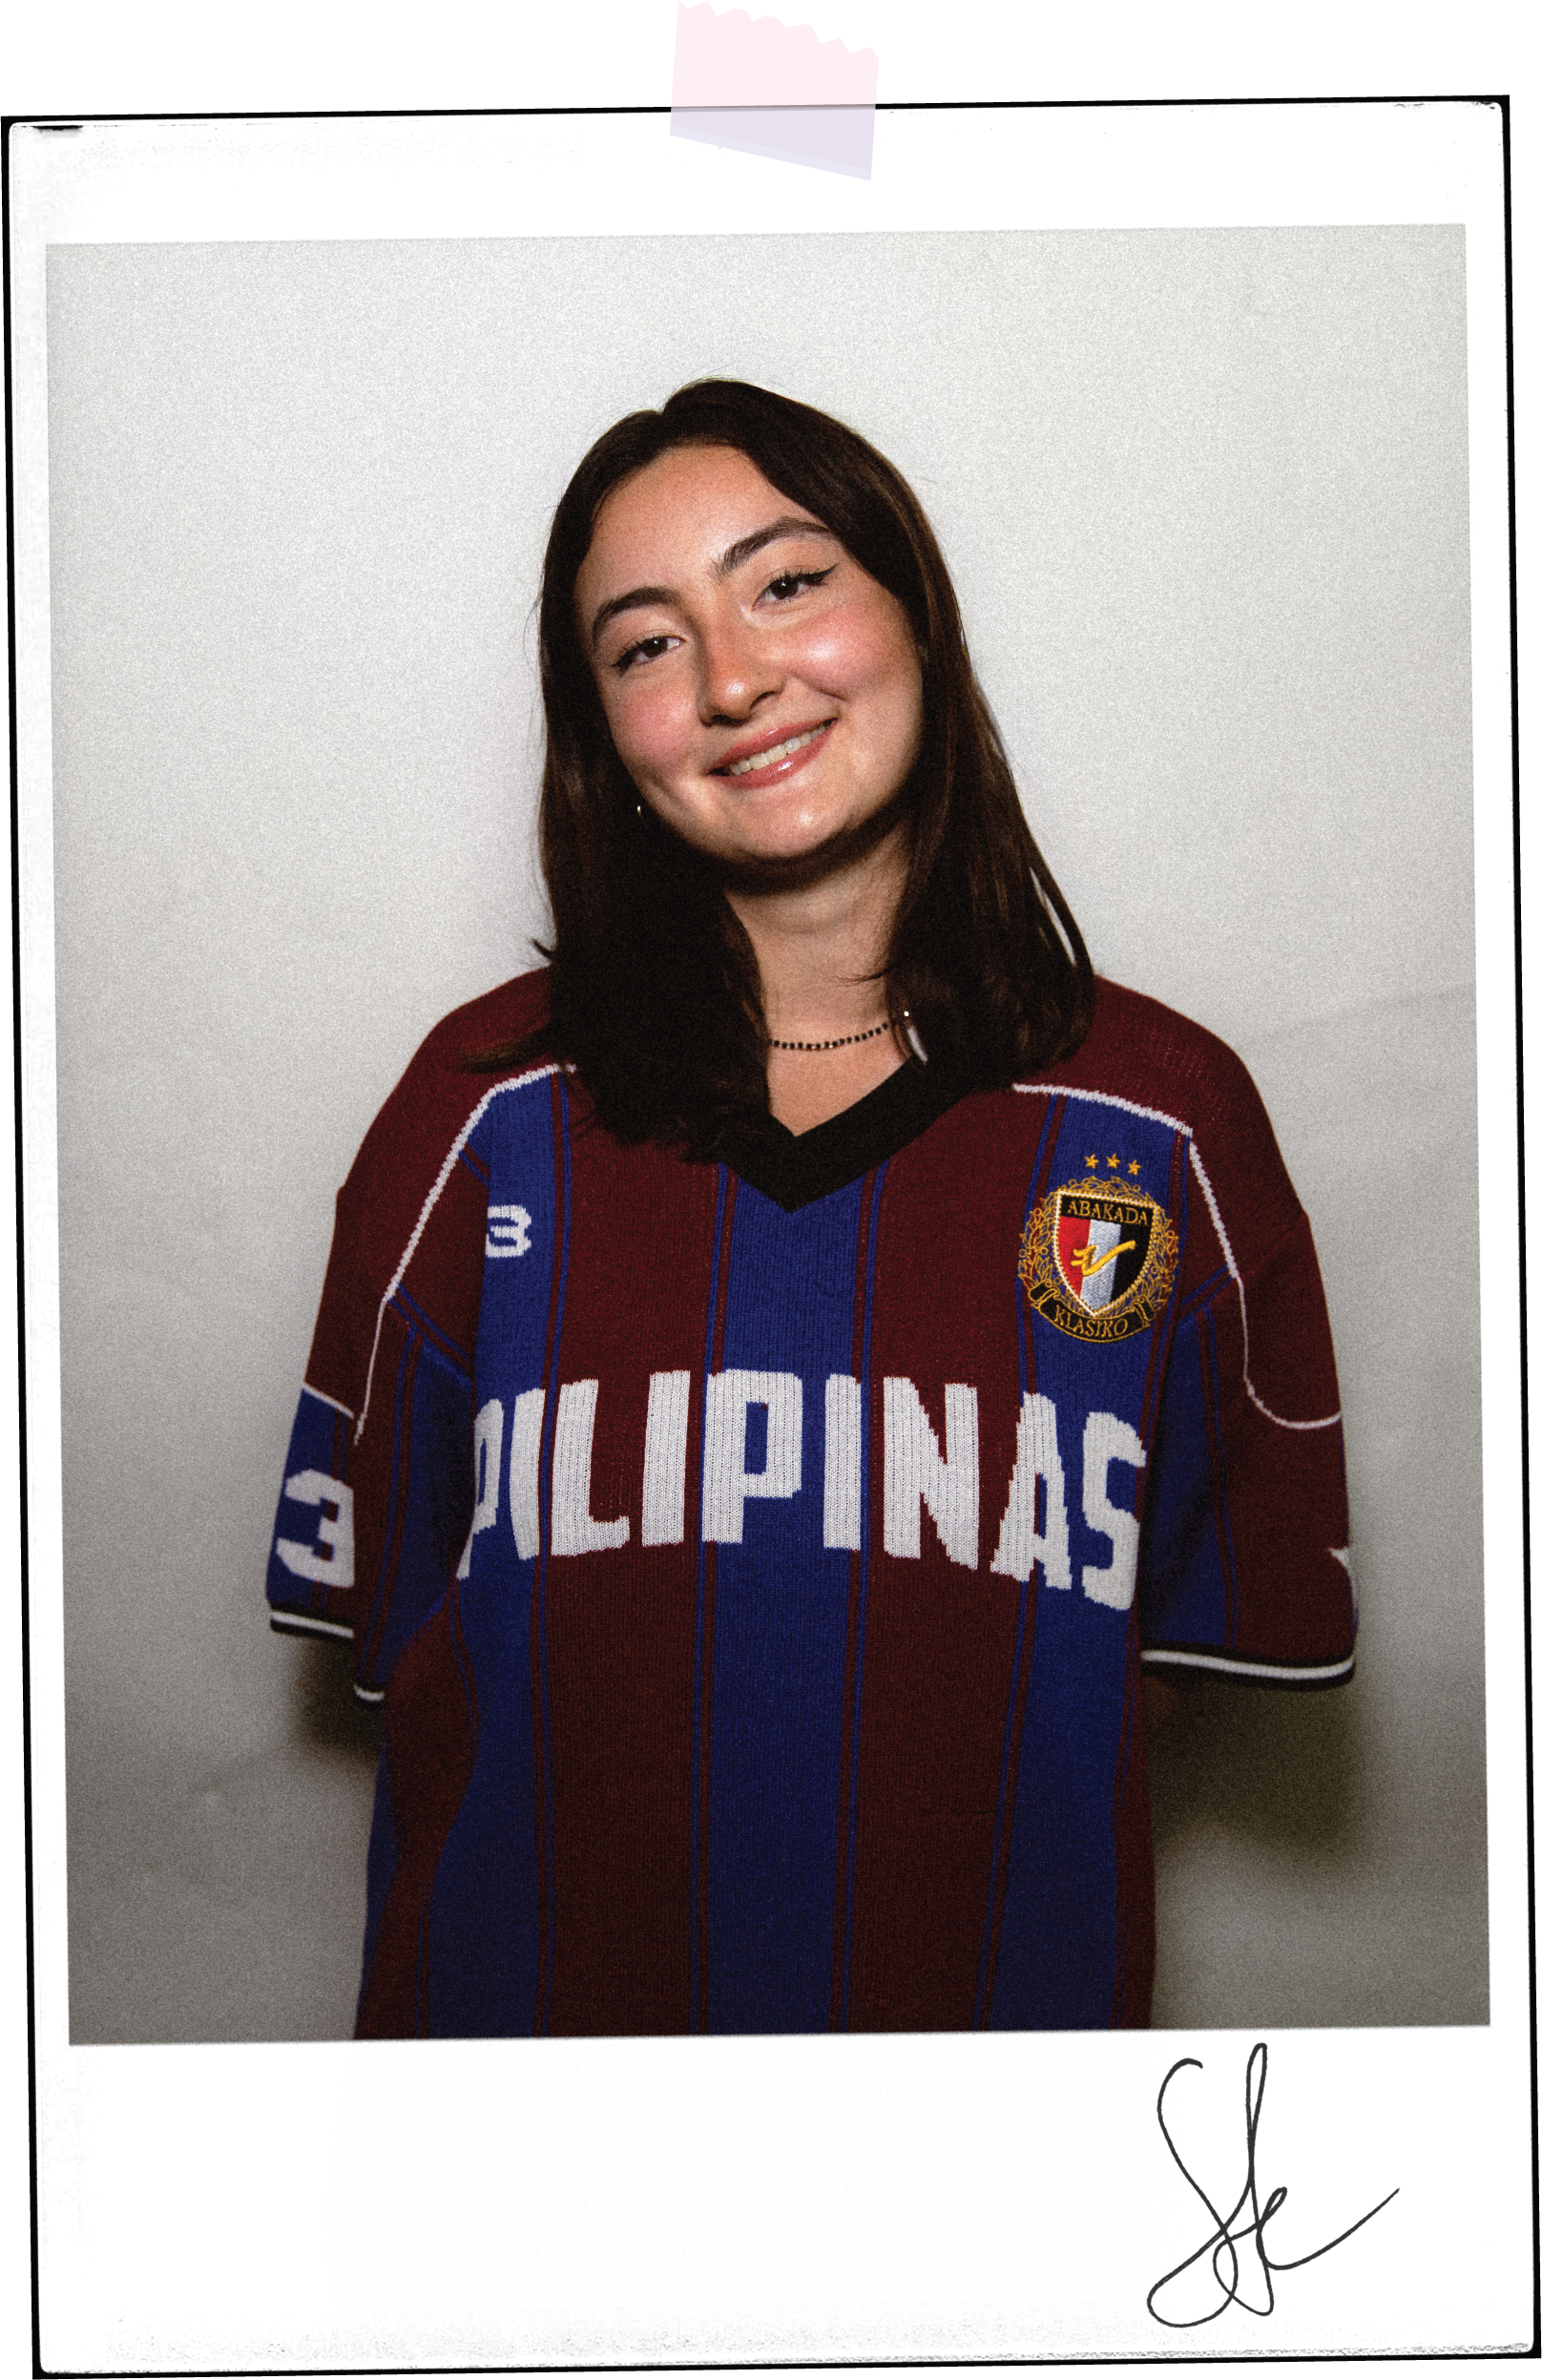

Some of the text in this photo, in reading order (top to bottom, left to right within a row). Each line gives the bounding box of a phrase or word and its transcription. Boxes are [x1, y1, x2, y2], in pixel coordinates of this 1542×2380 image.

[1067, 1200, 1148, 1226] ABAKADA
[1054, 1304, 1128, 1338] KLASIKO
[275, 1468, 355, 1589] 3
[455, 1368, 1146, 1612] PILIPINAS
